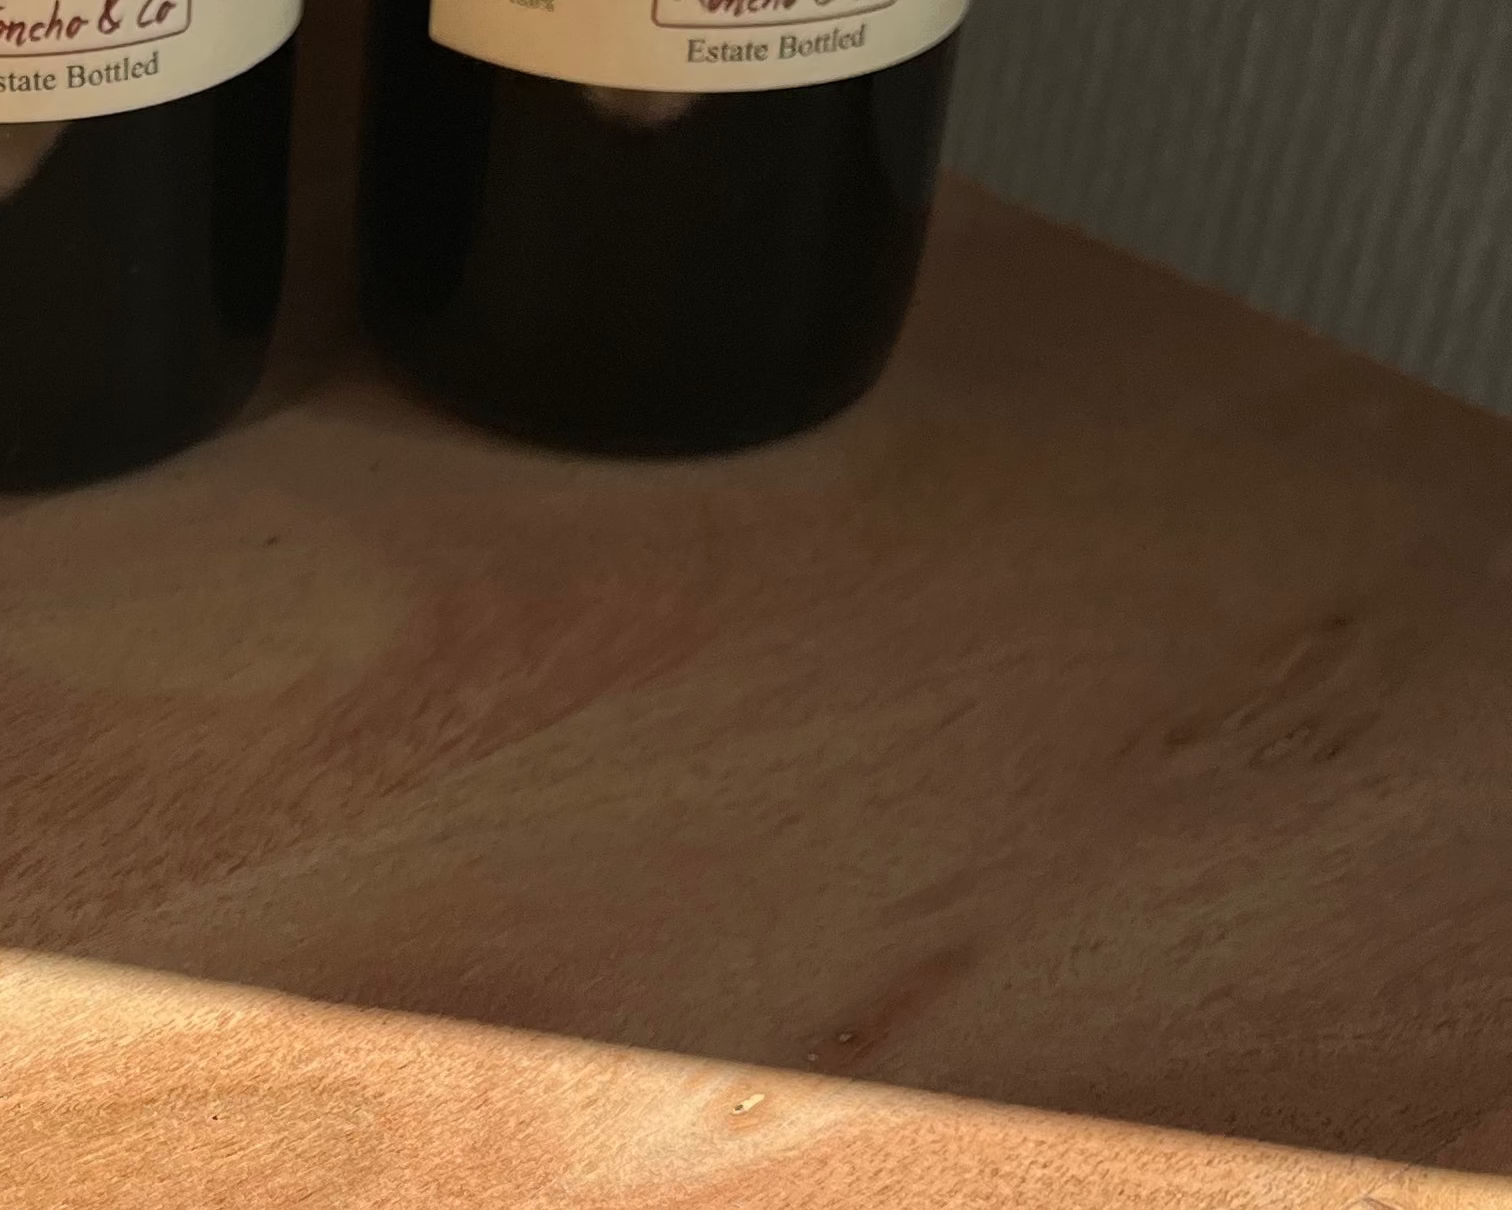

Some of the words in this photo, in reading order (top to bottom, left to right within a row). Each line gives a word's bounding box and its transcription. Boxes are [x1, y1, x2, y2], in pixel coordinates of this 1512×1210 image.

[98, 0, 122, 34] &
[138, 0, 177, 28] Co
[687, 39, 769, 63] Estate
[778, 24, 867, 60] Bottled
[67, 52, 160, 90] Bottled
